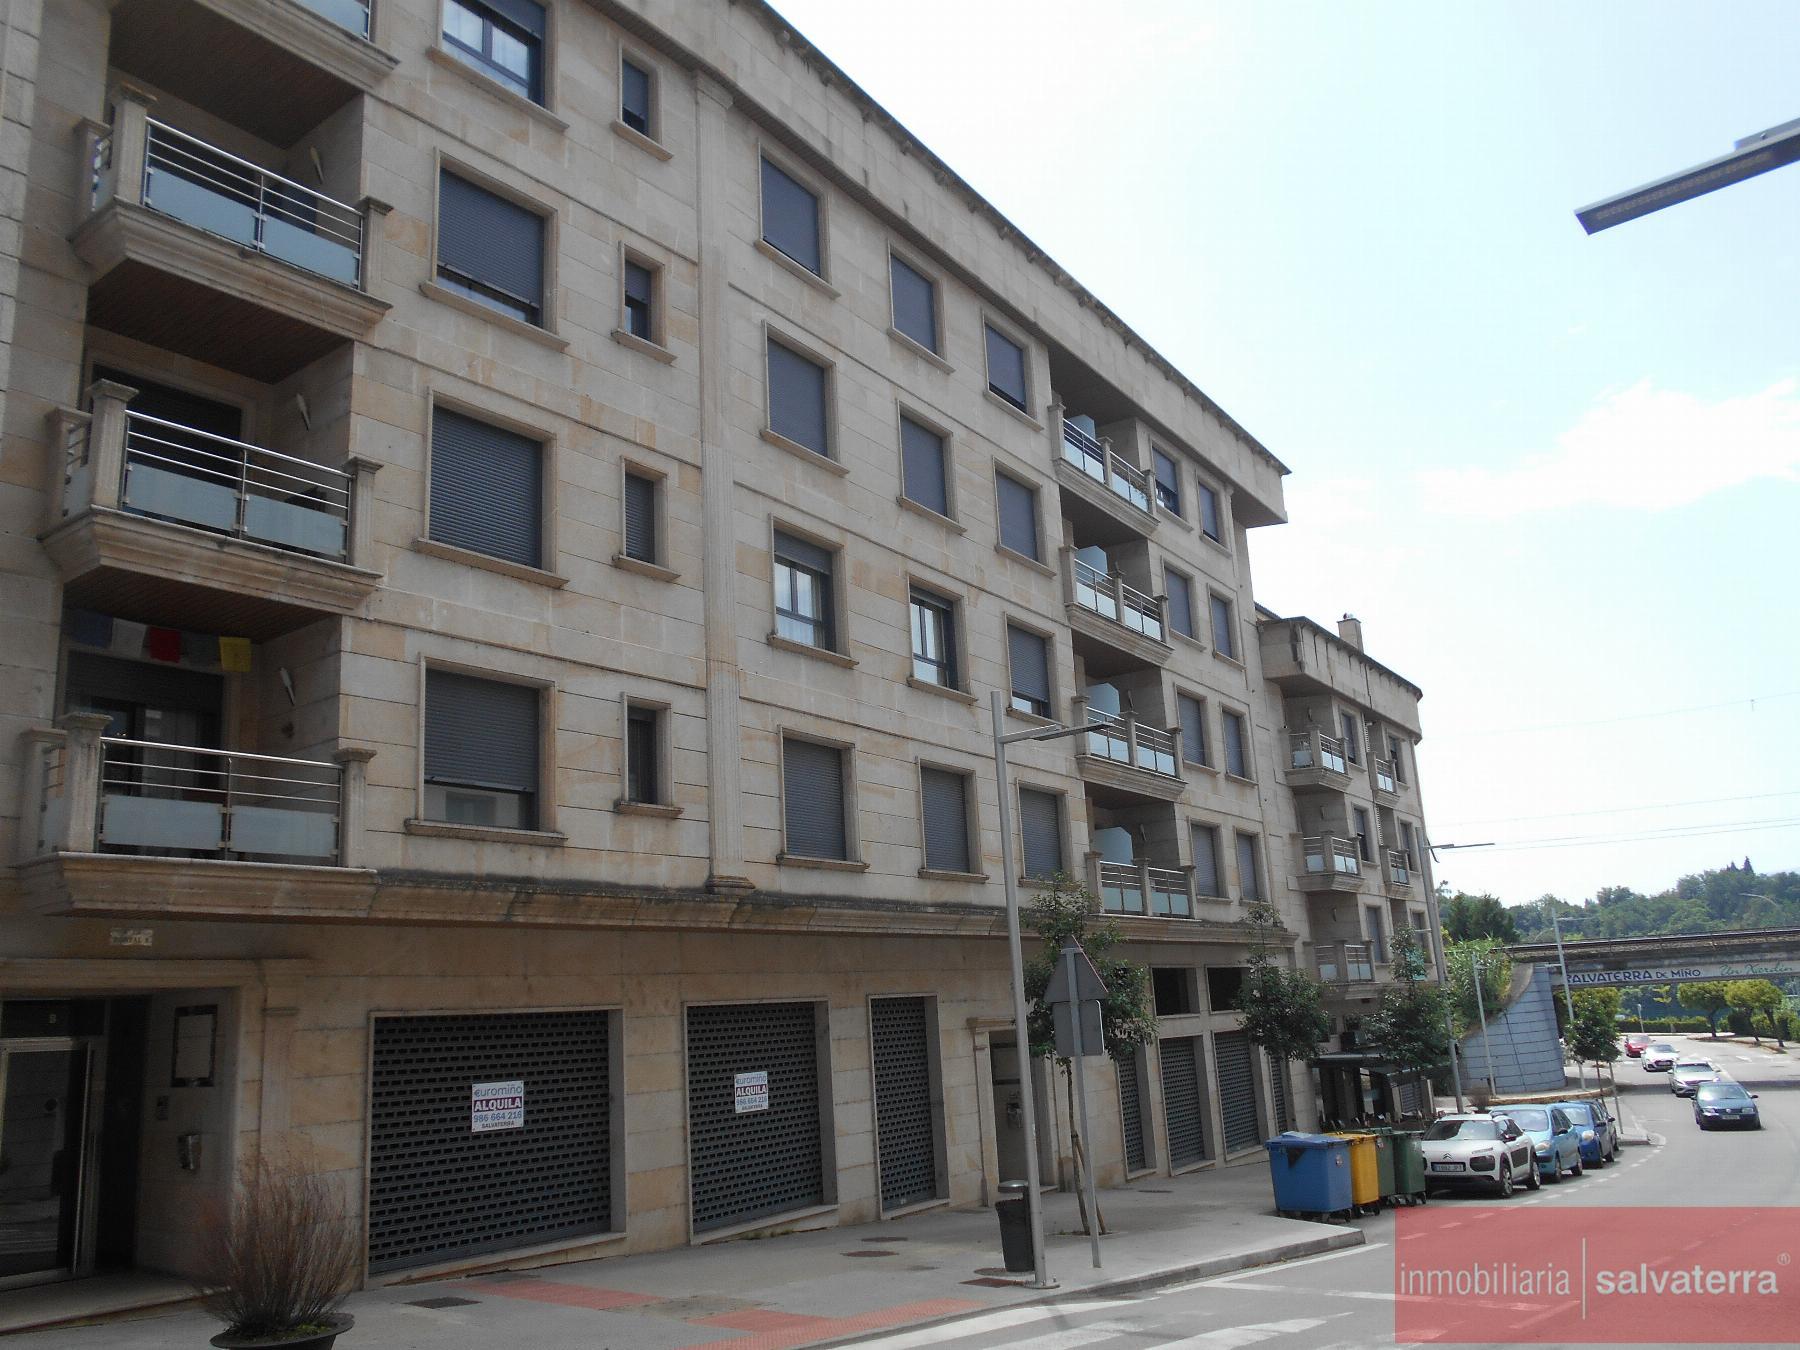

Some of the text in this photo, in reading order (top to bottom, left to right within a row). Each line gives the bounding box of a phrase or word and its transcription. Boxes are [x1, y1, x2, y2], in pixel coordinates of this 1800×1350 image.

[1671, 968, 1701, 978] MIÑO
[736, 1084, 766, 1097] ALQUILA
[475, 1097, 521, 1111] ALQUILA
